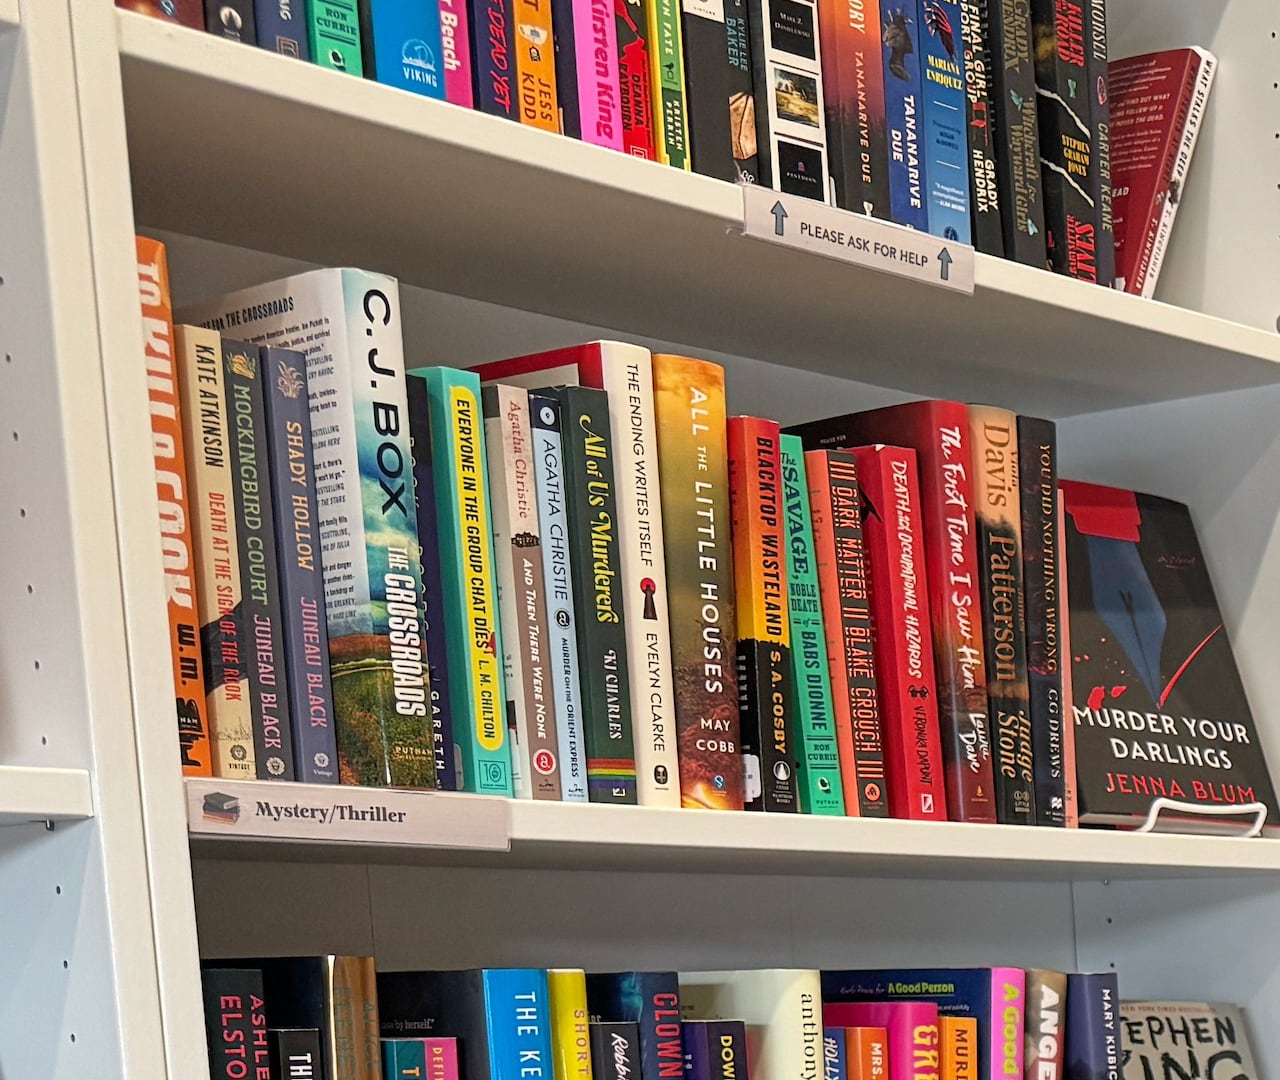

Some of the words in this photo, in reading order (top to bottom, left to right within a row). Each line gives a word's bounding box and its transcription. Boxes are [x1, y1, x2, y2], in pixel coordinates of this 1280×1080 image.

[403, 67, 437, 88] VIKING
[854, 52, 869, 148] TANANARIVE
[861, 153, 872, 183] DUE
[800, 221, 845, 248] PLEASE
[846, 234, 871, 253] ASK
[872, 241, 897, 260] FOR
[899, 247, 929, 267] HELP
[362, 288, 392, 339] C.
[195, 343, 217, 386] KATE
[367, 355, 396, 390] J.
[199, 390, 224, 468] ATKINSON
[689, 386, 708, 437] ALL
[233, 384, 263, 537] MOCKINGBIRD
[371, 401, 408, 515] BOX
[696, 445, 708, 471] THE
[983, 421, 1009, 509] Davis
[694, 479, 718, 574] LITTLE
[246, 536, 268, 606] COURT
[385, 544, 409, 582] THE
[588, 511, 621, 625] Murderers
[988, 533, 1019, 682] Patterson
[254, 614, 276, 686] JUNEAU
[384, 570, 428, 718] CROSSROADS
[700, 583, 724, 695] HOUSES
[260, 692, 282, 749] BLACK
[700, 717, 731, 733] MAY
[1073, 704, 1179, 737] MURDER
[1187, 720, 1251, 745] YOUR
[695, 739, 736, 755] COBB
[1109, 737, 1233, 771] DARLINGS
[256, 801, 407, 825] Mystery/Thriller
[1103, 773, 1187, 799] JENNA
[1194, 781, 1256, 805] BLUM
[514, 991, 537, 1036] THE
[652, 993, 682, 1076] CLOWN
